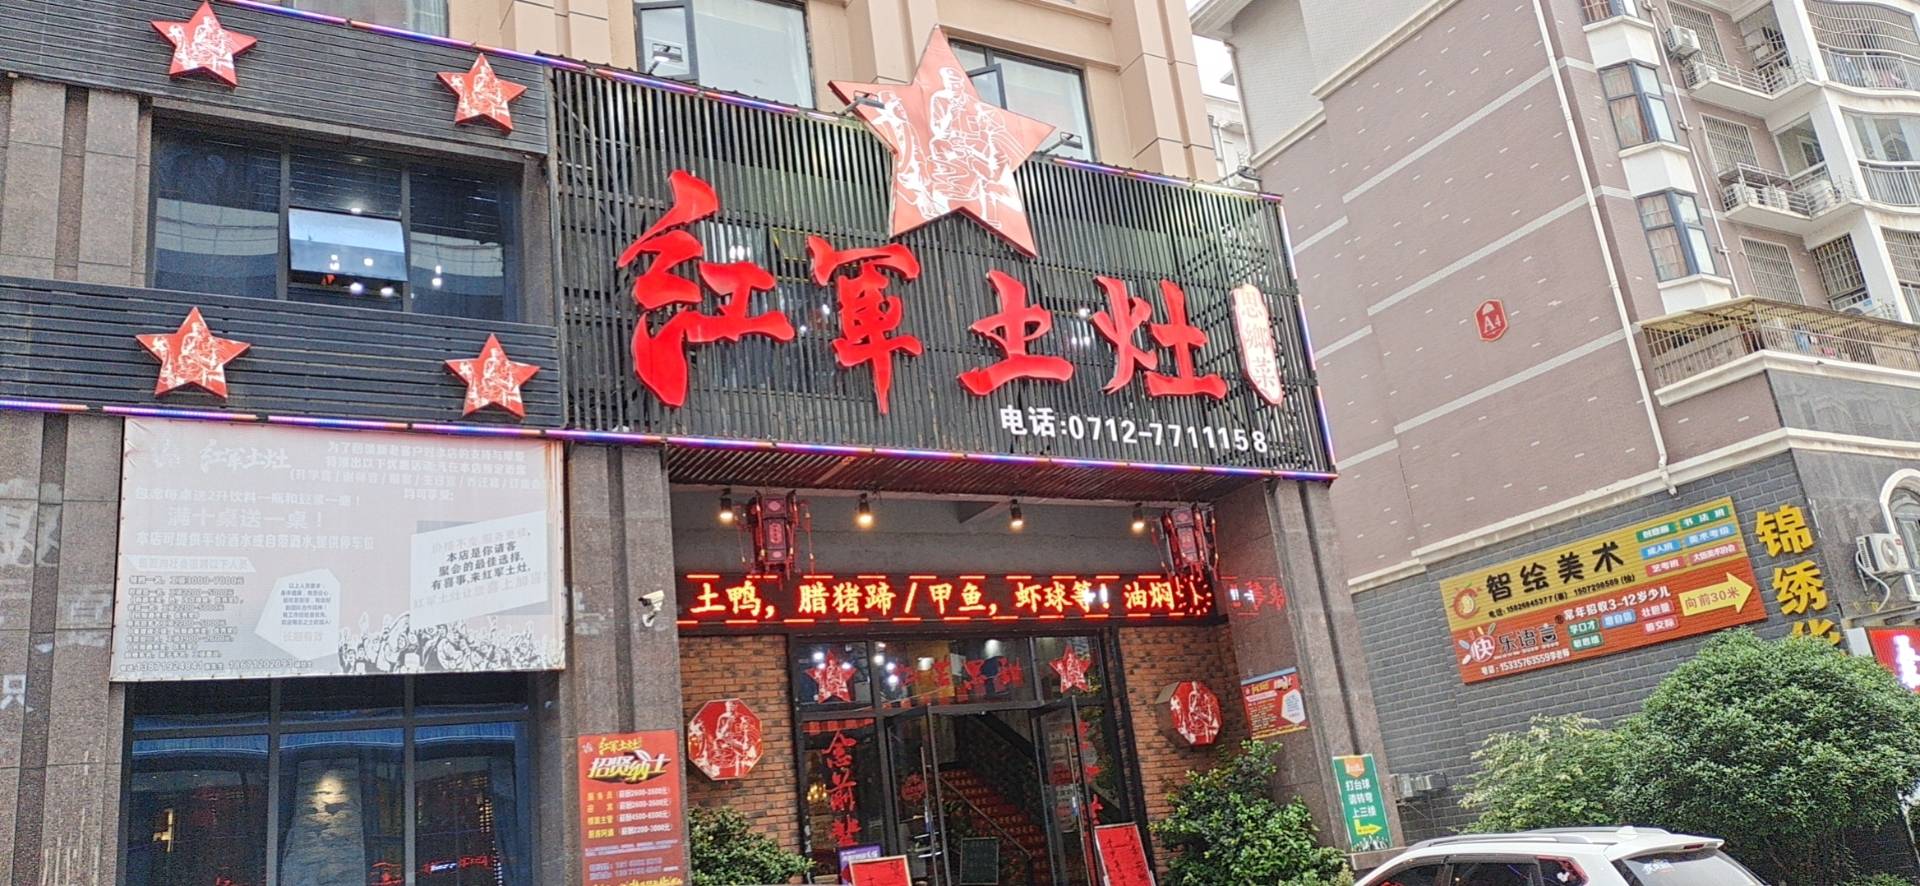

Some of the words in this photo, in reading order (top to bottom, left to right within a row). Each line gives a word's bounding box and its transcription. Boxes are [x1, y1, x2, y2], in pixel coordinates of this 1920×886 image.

[617, 169, 1228, 414] 红军土灶
[1000, 404, 1268, 453] 电话:0712-7711158
[446, 540, 518, 562] 本店是你请客
[1486, 541, 1624, 602] 智绘美术
[1563, 586, 1671, 621] 常年招收3-12岁少儿
[1685, 586, 1740, 609] 向前30米
[1352, 805, 1377, 818] 上三楼
